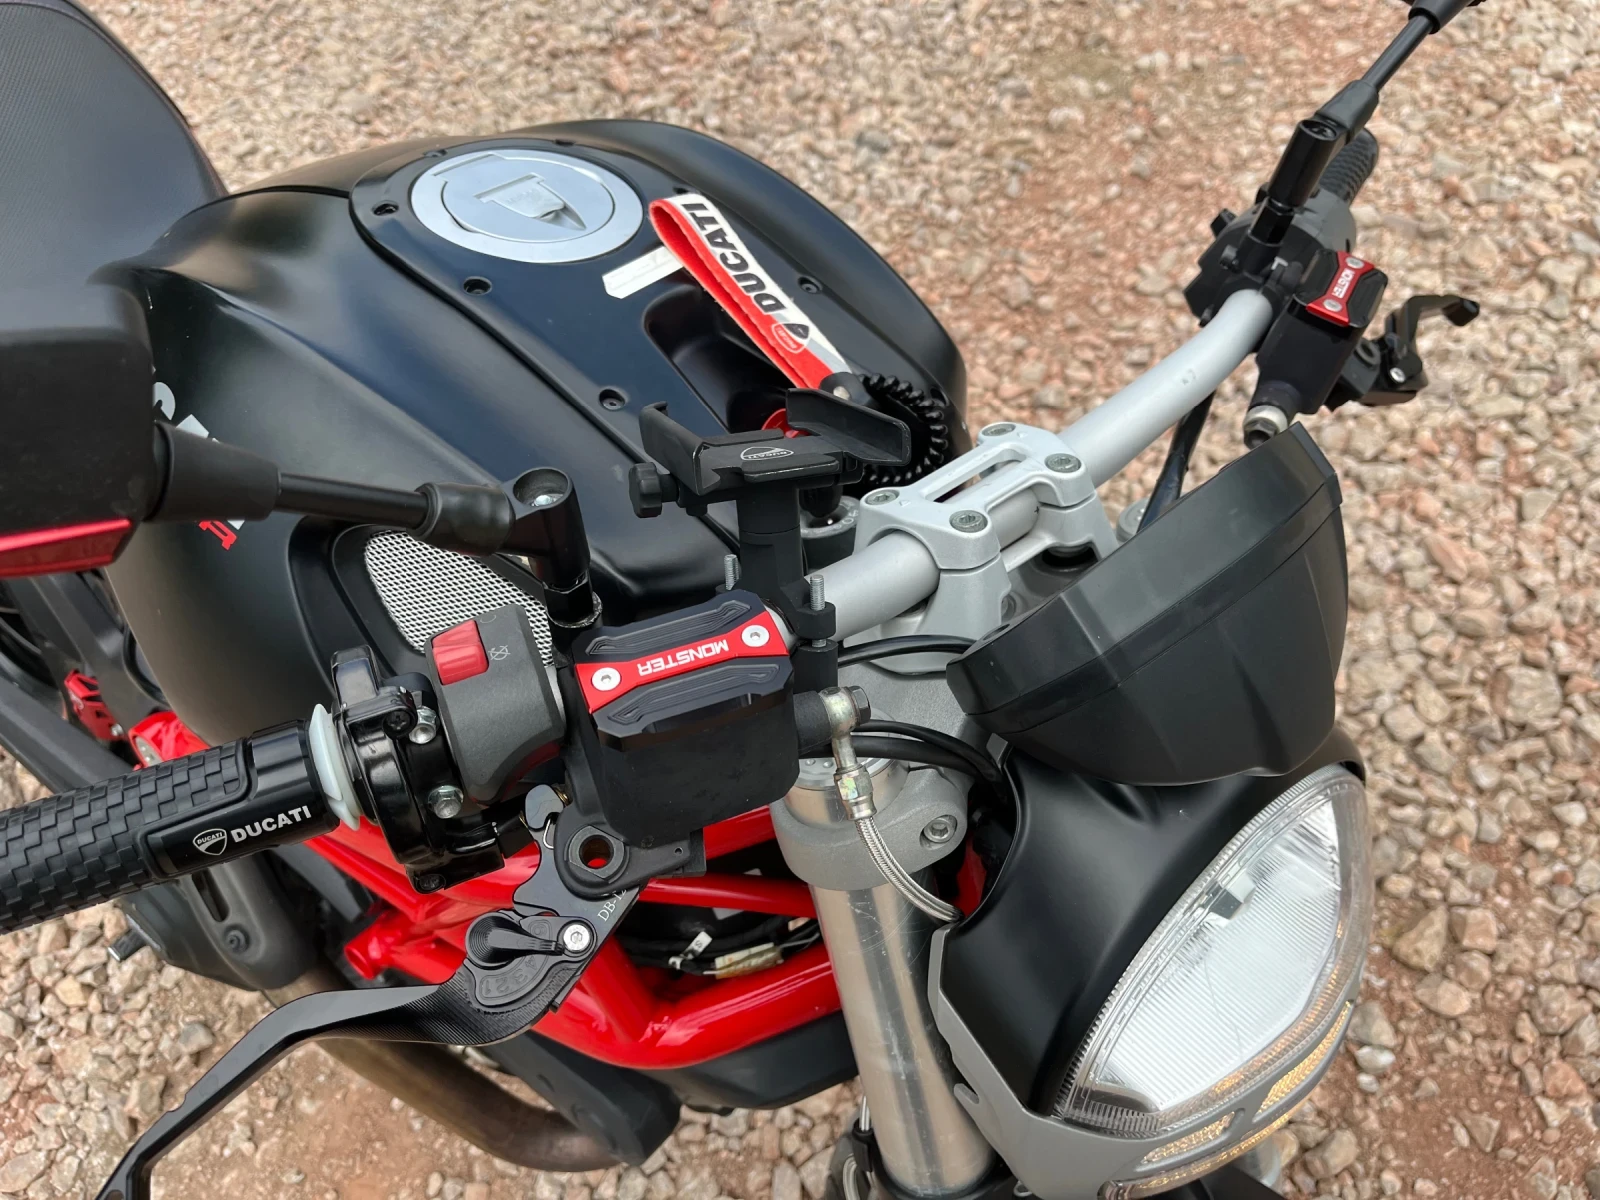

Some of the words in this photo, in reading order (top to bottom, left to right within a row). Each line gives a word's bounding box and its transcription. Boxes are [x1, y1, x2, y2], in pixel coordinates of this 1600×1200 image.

[681, 203, 787, 313] DUCATI
[747, 451, 787, 459] DUCATI
[637, 639, 728, 676] MONSTER
[197, 832, 223, 845] DUCATI
[231, 806, 311, 842] DUCATI
